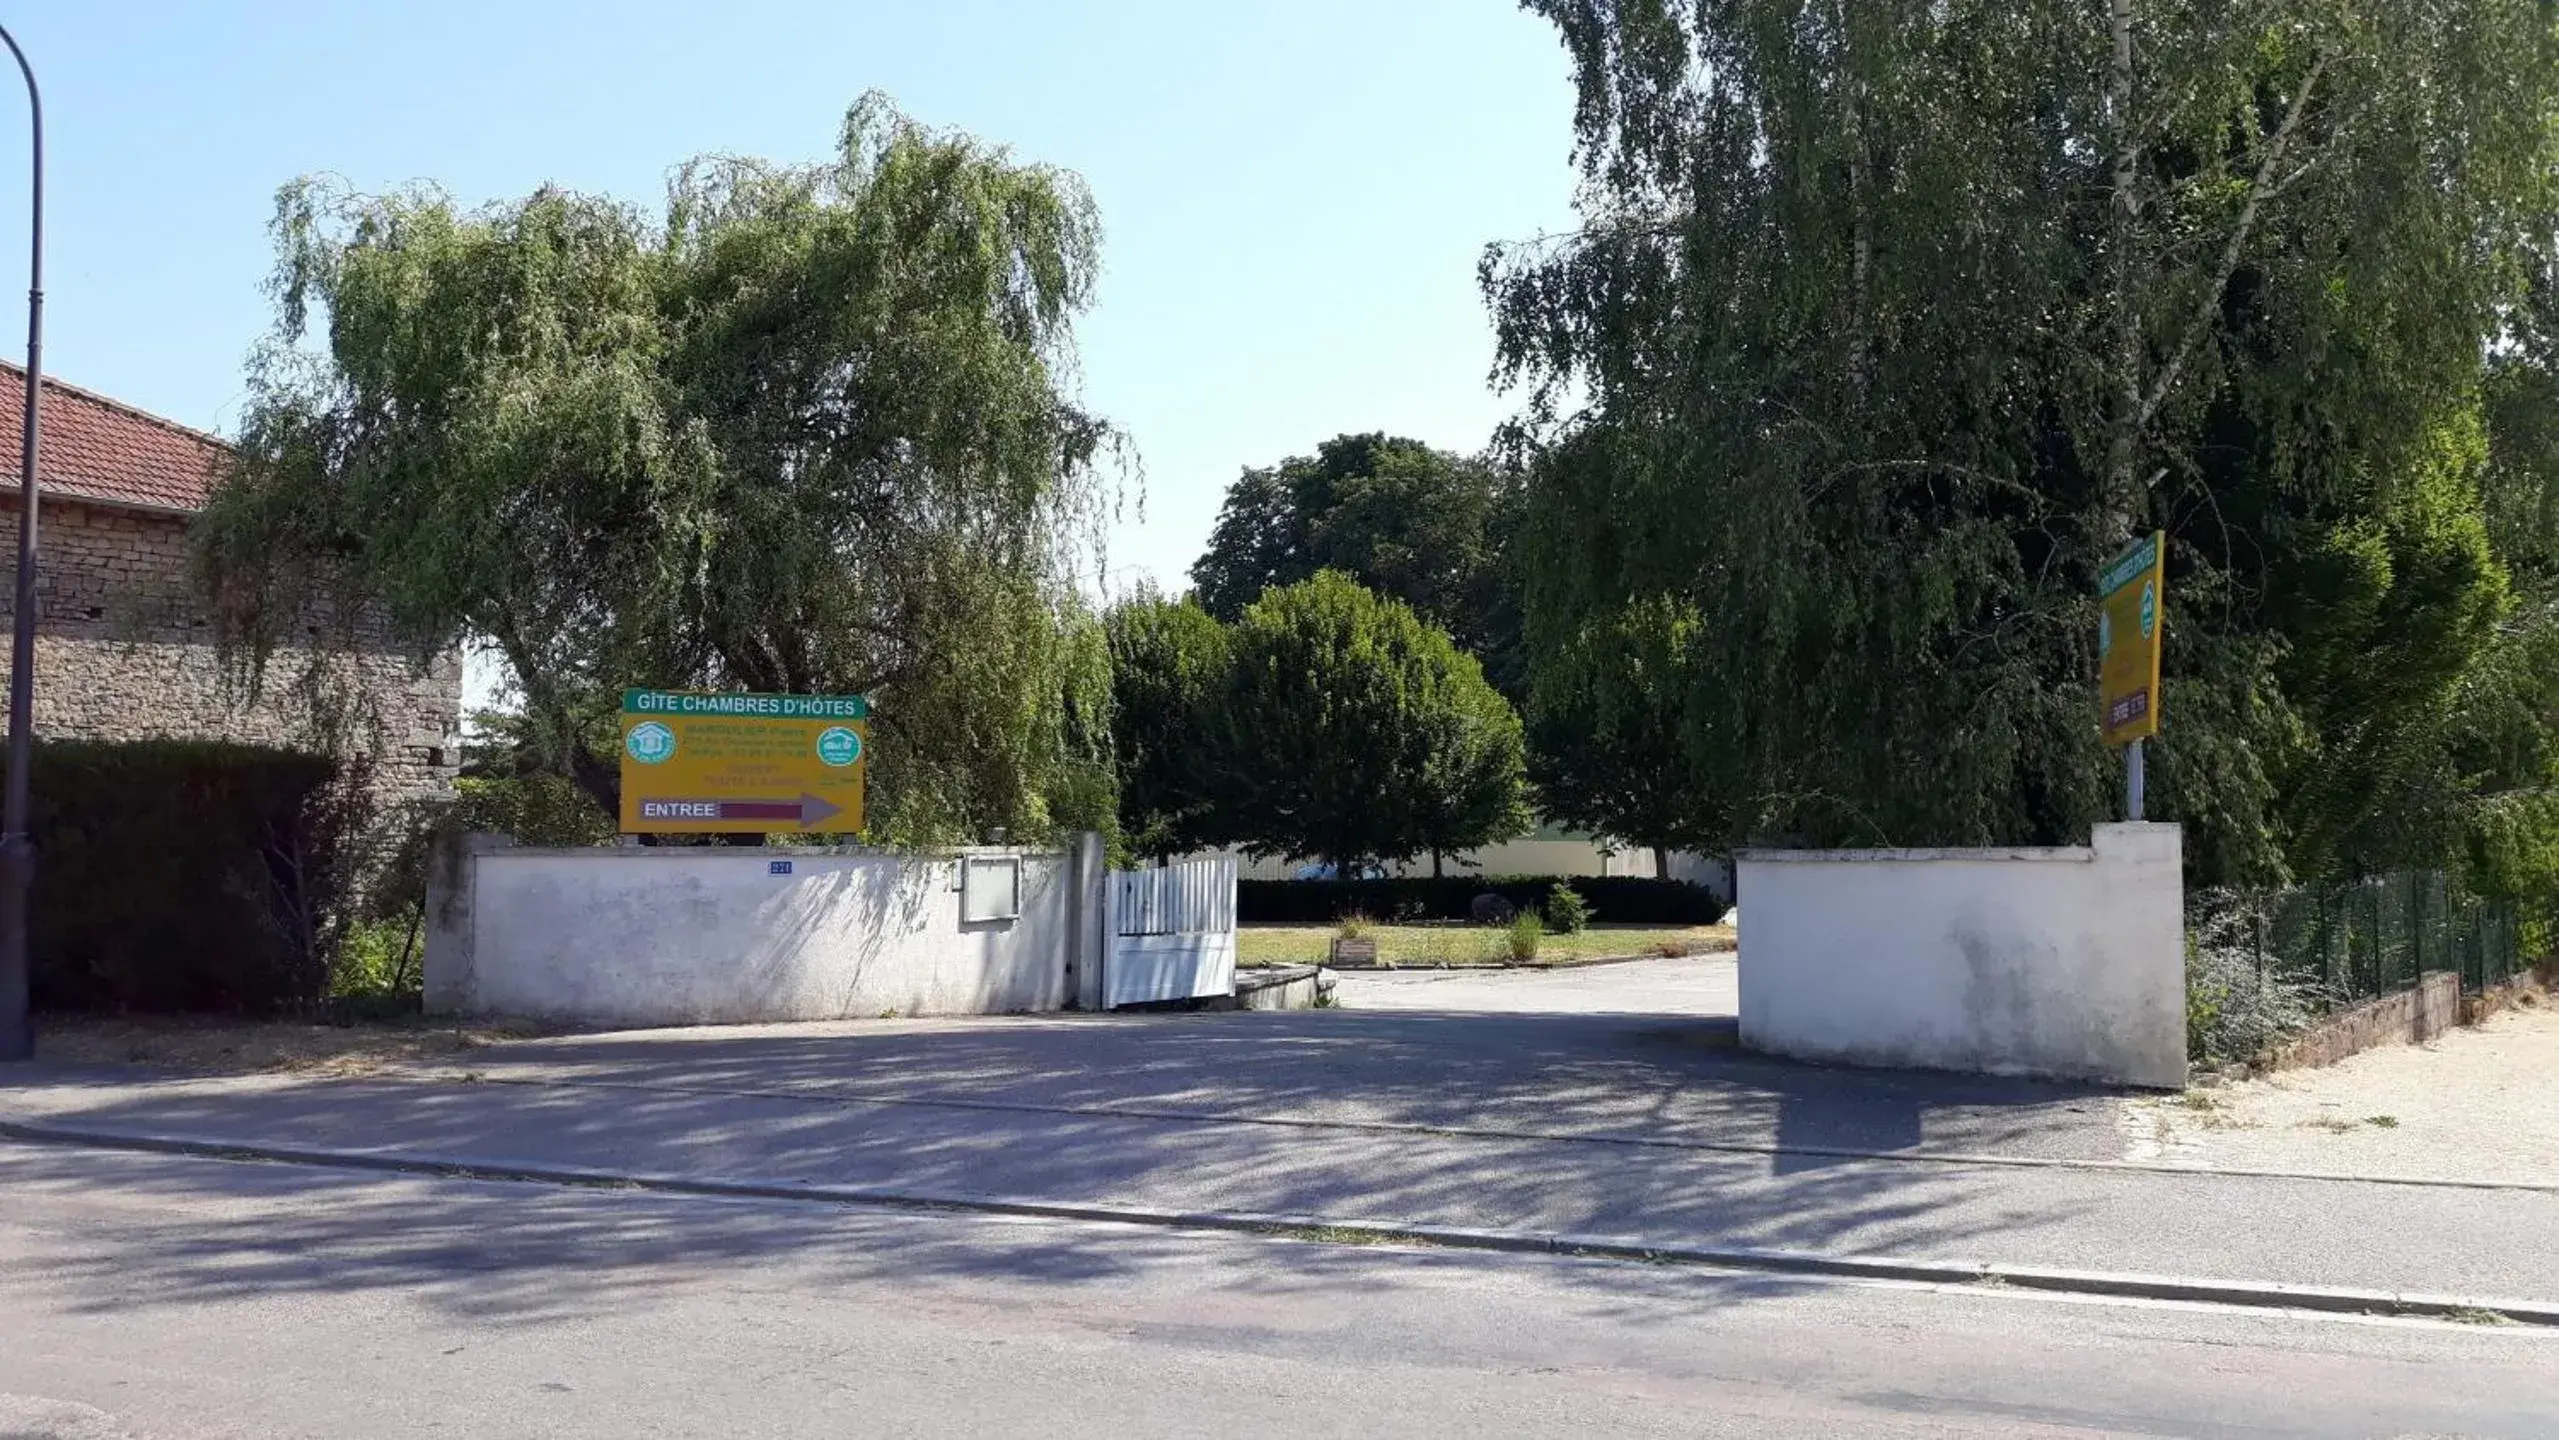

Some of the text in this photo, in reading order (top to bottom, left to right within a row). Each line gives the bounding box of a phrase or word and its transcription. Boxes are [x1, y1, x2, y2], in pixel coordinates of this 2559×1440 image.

[637, 692, 855, 716] GÎTE CHAMBRES D'HÔTES
[644, 803, 716, 818] ENTREE
